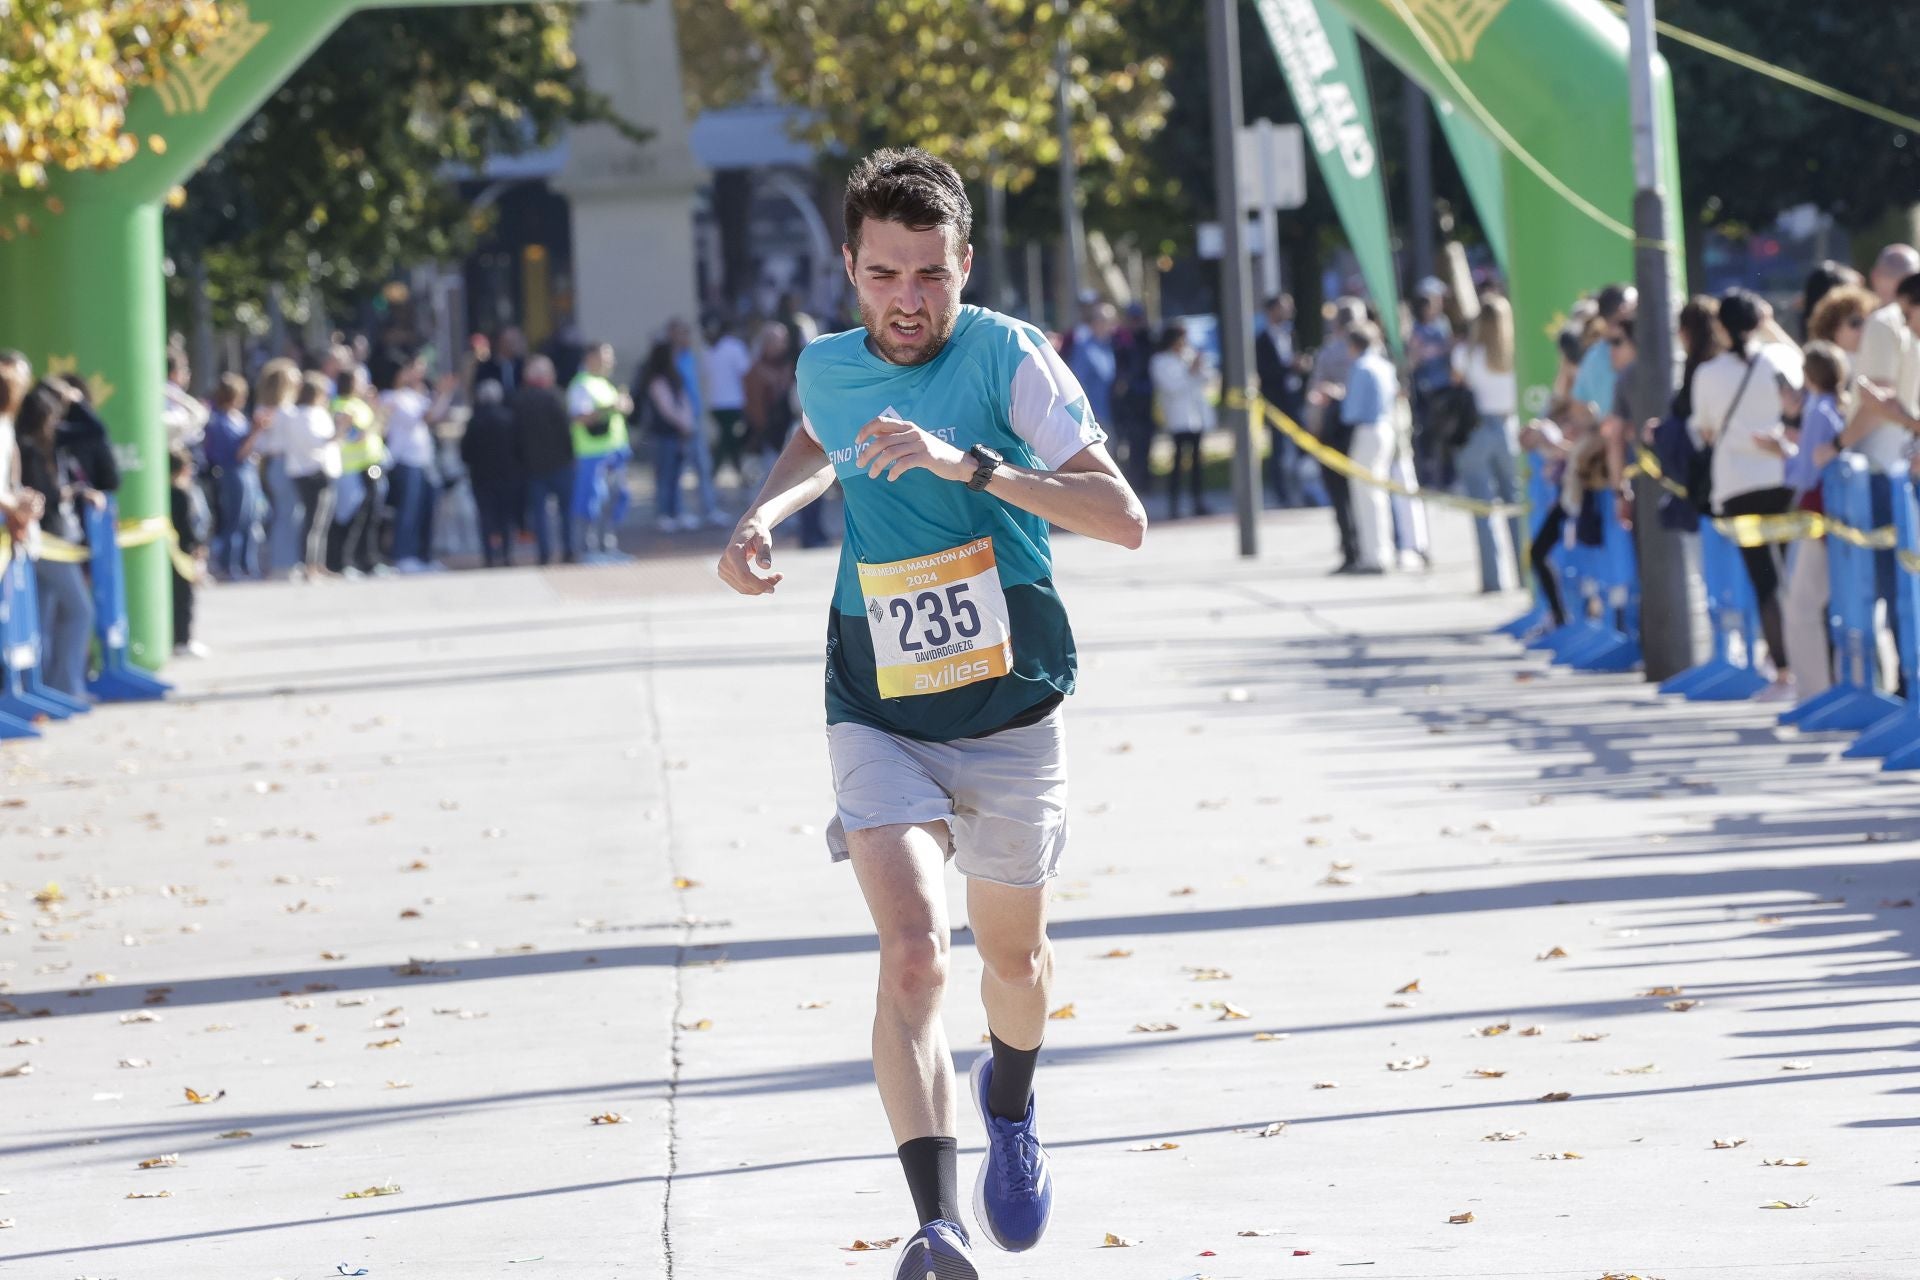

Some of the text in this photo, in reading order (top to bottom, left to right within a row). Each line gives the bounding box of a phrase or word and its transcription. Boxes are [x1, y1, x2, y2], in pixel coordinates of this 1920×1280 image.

[829, 447, 852, 464] FIND
[879, 565, 906, 577] MEDIA
[907, 552, 957, 571] MARATÓN
[958, 540, 989, 559] AVILÉS
[906, 572, 938, 587] 2024
[888, 583, 982, 652] 235
[914, 660, 989, 690] avilés
